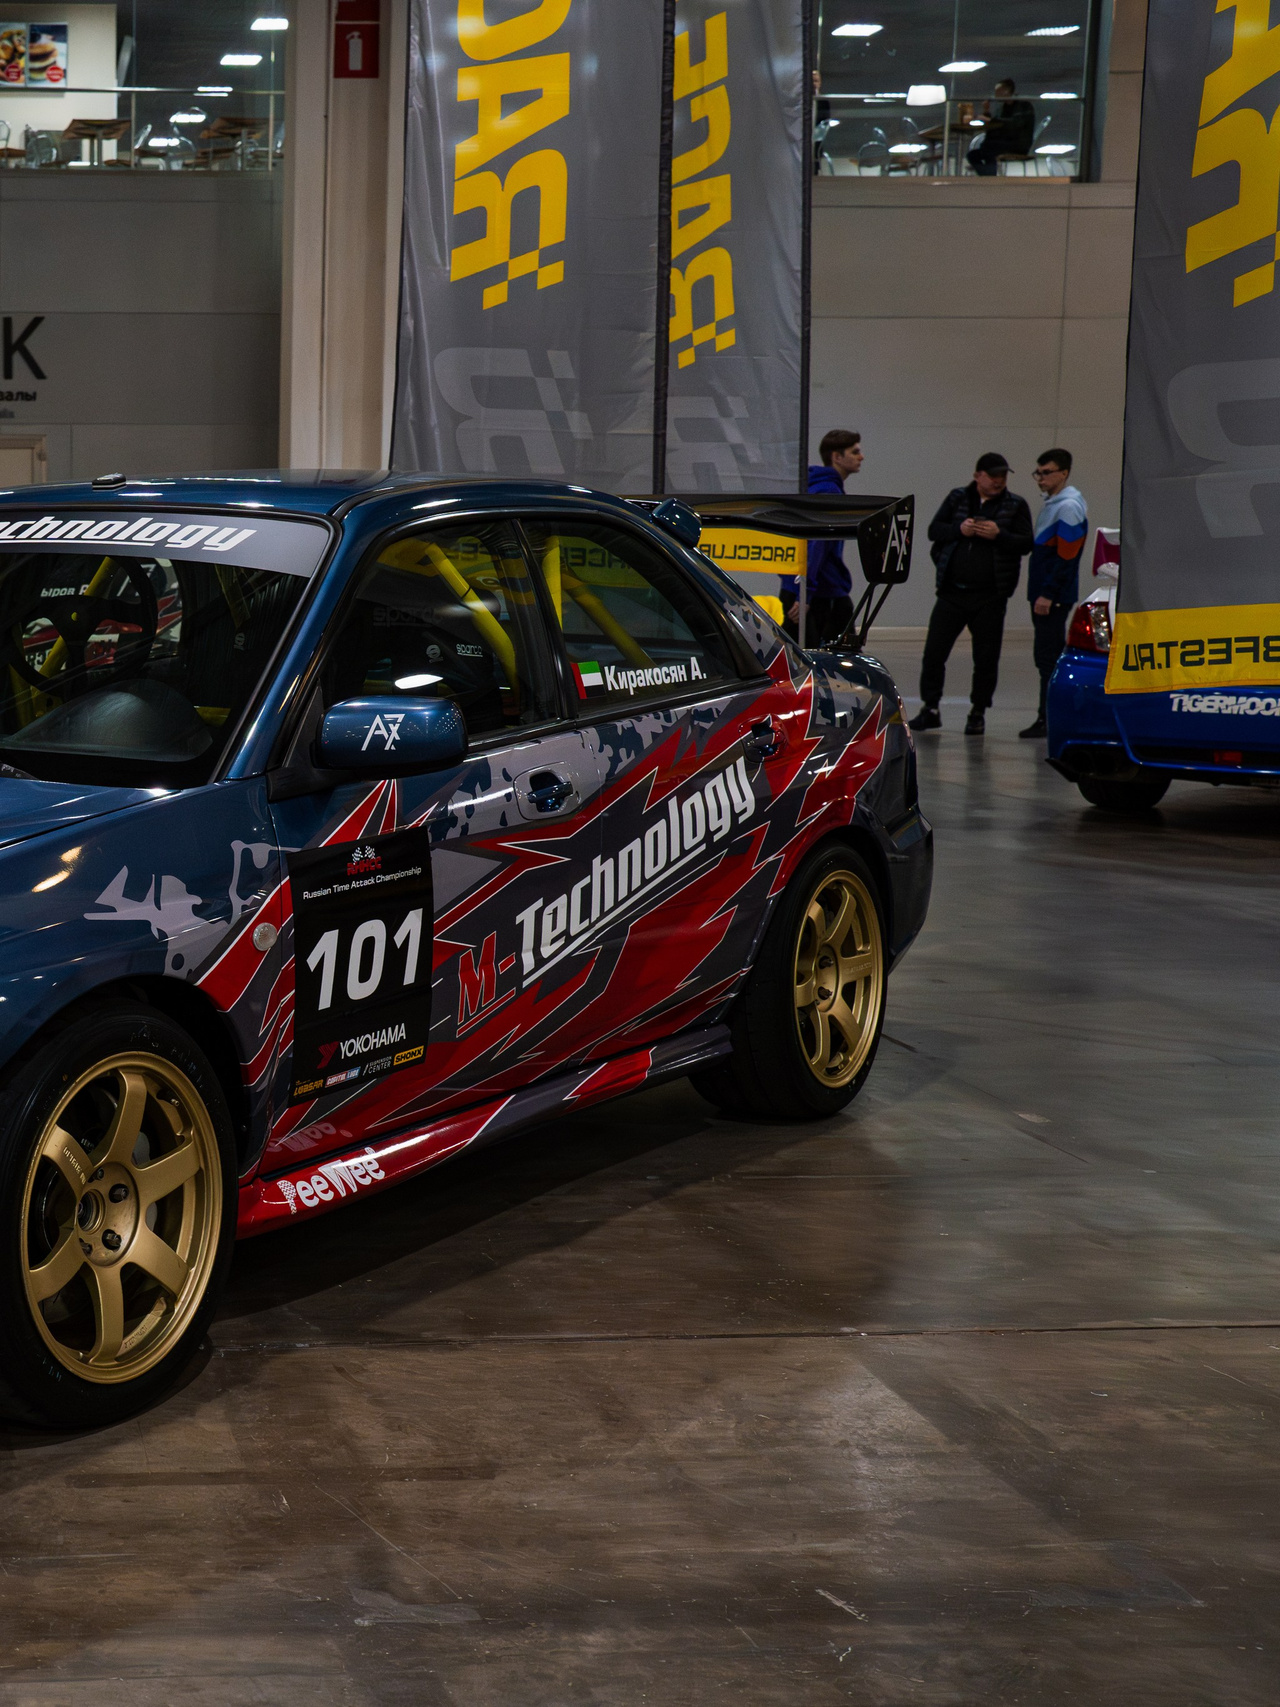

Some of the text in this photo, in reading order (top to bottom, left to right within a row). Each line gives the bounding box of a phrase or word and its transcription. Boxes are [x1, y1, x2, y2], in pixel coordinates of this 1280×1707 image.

[604, 664, 687, 696] Киракосян
[303, 866, 422, 900] Russian Time Attack Championship
[457, 756, 756, 1032] M-Technology
[306, 908, 424, 1011] 101
[340, 1022, 406, 1060] YOKOHAMA
[368, 1060, 392, 1075] CENTER
